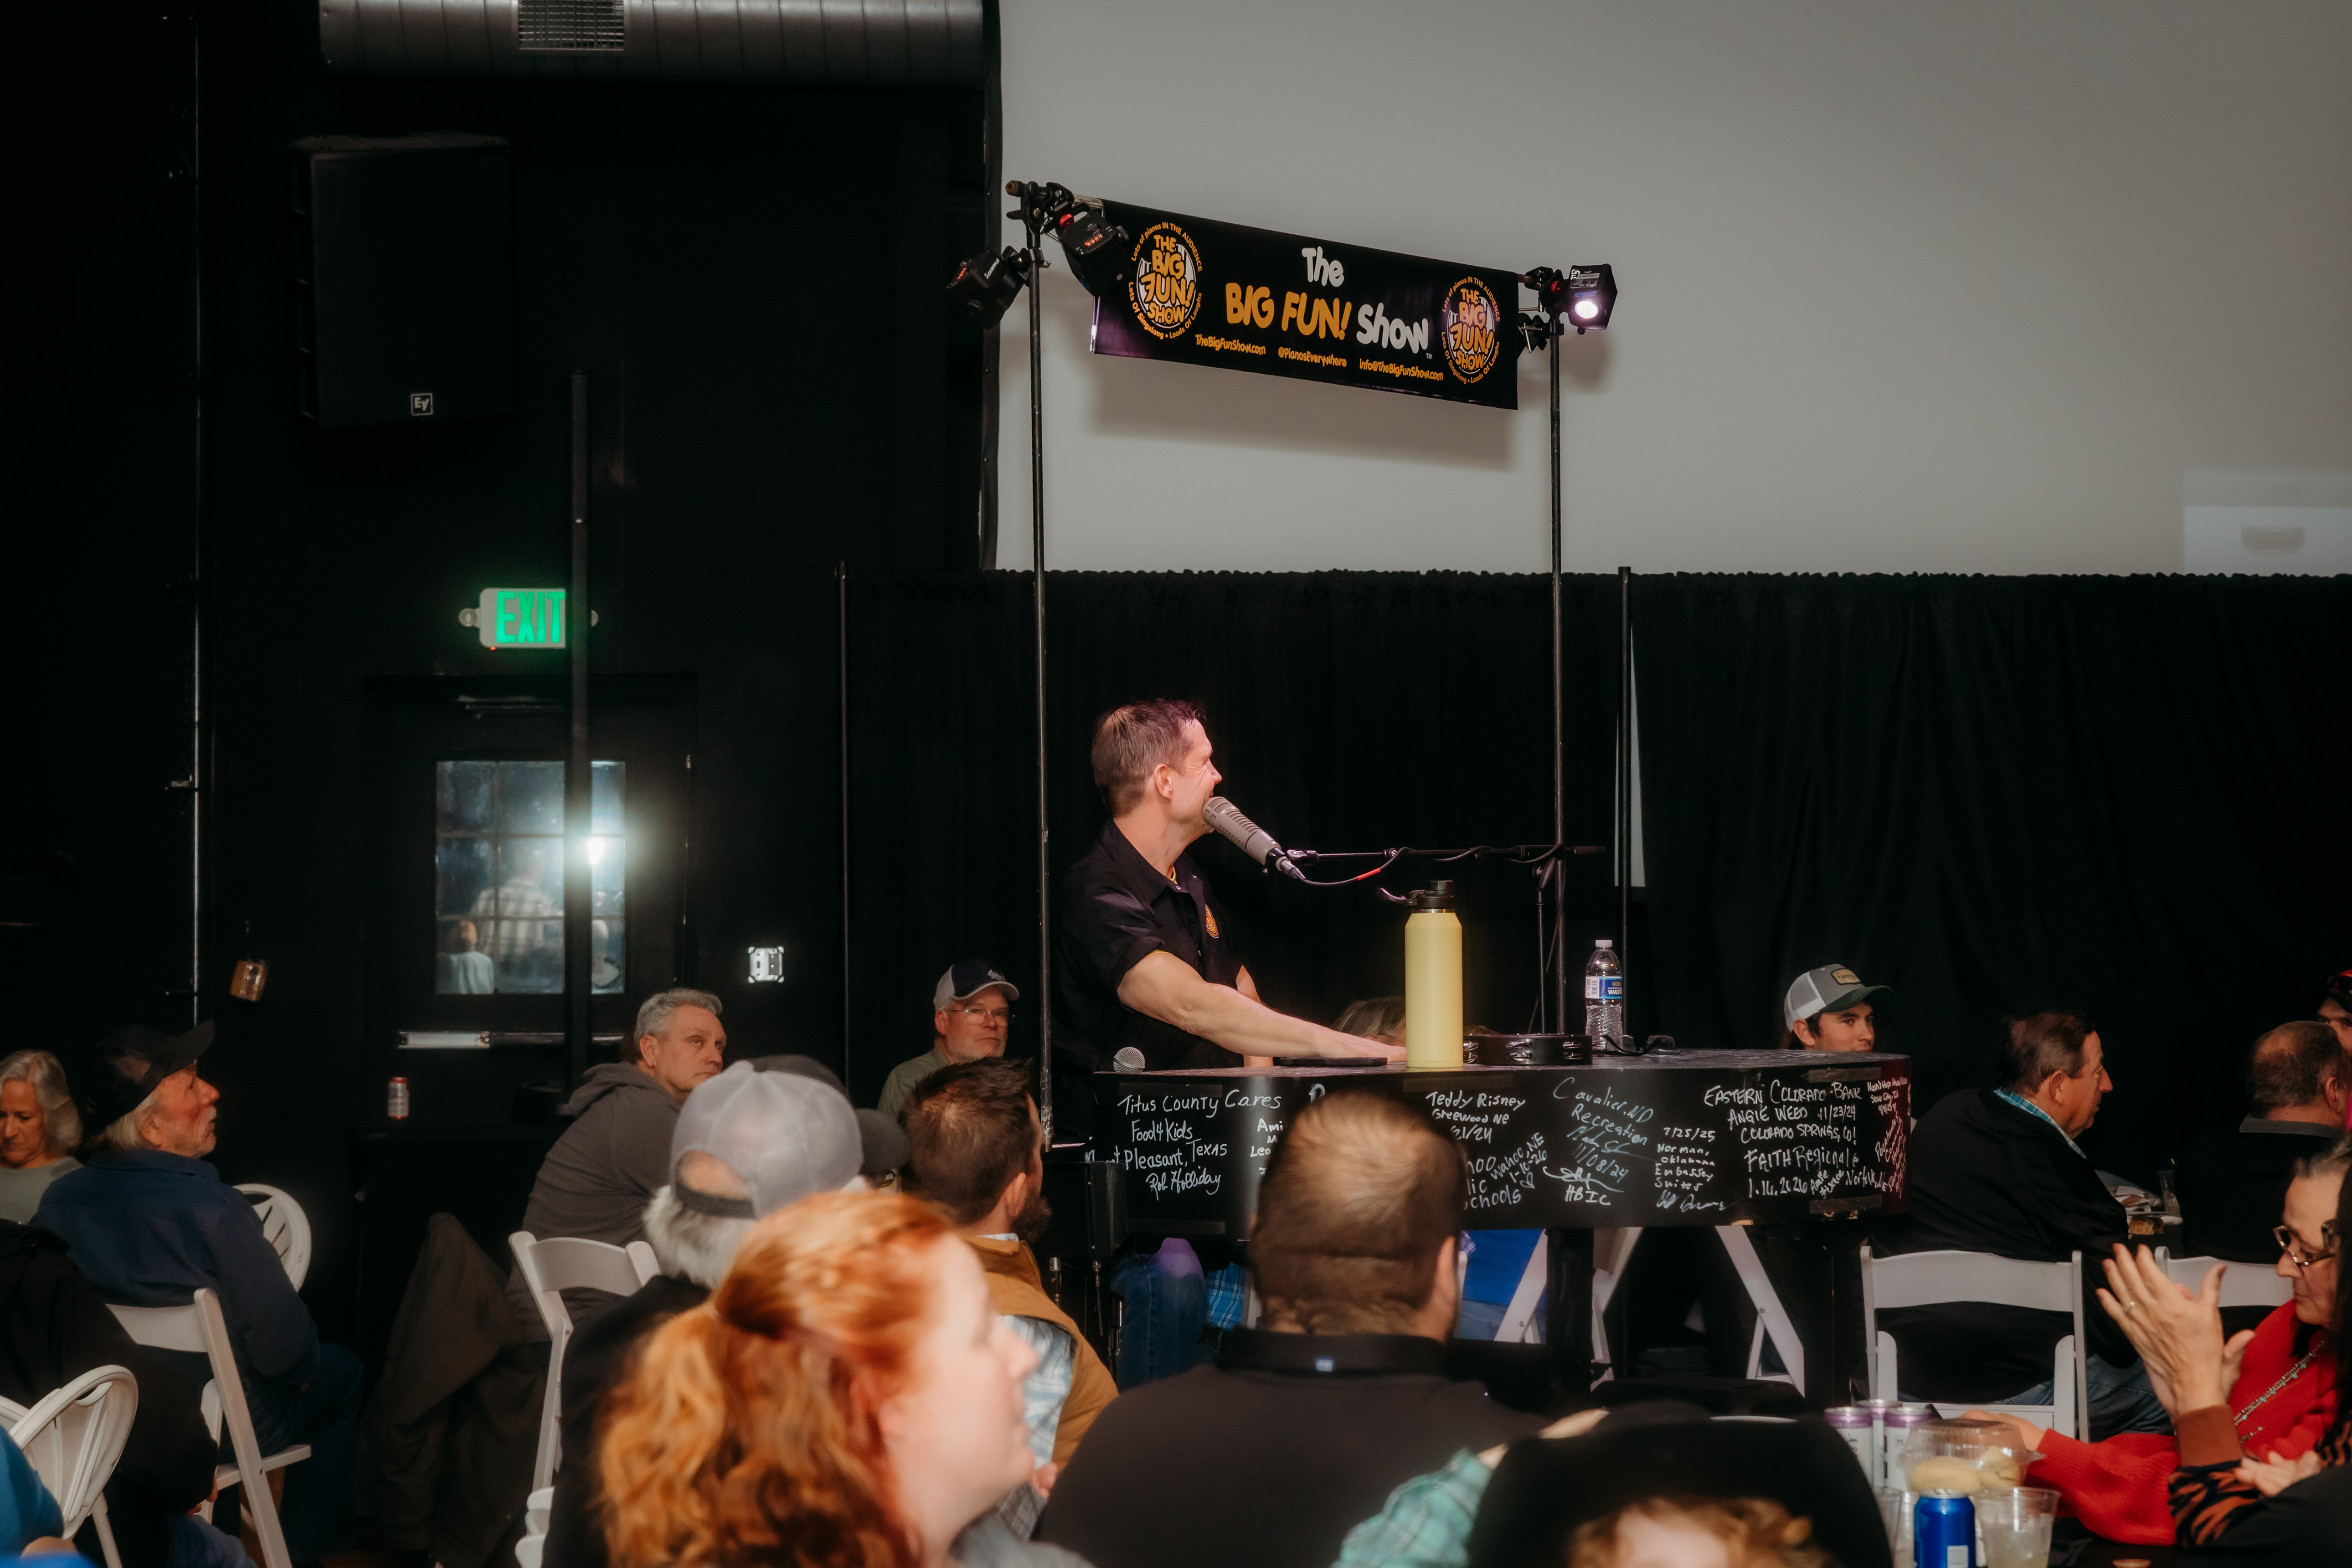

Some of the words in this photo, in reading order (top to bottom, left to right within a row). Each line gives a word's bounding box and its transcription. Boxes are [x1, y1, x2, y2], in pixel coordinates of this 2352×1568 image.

[1131, 244, 1141, 262] Lots
[1139, 234, 1145, 244] of
[1144, 224, 1161, 239] pianos
[1170, 223, 1182, 235] THE
[1182, 232, 1203, 272] AUDIENCE
[1153, 235, 1176, 252] THE
[1152, 250, 1184, 280] BIG
[1302, 246, 1344, 287] The
[1141, 272, 1195, 307] FUN!
[1449, 288, 1453, 297] of
[1453, 278, 1467, 292] pianos
[1474, 277, 1483, 288] THE
[1483, 286, 1501, 322] AUDIENCE
[1461, 288, 1479, 305] THE
[1132, 302, 1140, 313] Of
[1137, 313, 1164, 339] Singalong
[1169, 327, 1185, 339] Loads
[1185, 318, 1192, 329] Of
[1190, 293, 1202, 321] Laughs
[1147, 302, 1185, 324] SHOW
[1225, 283, 1274, 329] BIG
[1281, 291, 1352, 340] FUN!
[1459, 302, 1486, 329] BIG
[1450, 323, 1494, 355] FUN!
[1448, 360, 1467, 384] Singalong
[1471, 373, 1483, 383] Loads
[1488, 341, 1500, 366] Laughs
[1455, 350, 1484, 370] SHOW
[496, 591, 566, 643] EXIT
[1117, 1095, 1156, 1115] Titus
[1225, 1089, 1282, 1109] Cares
[1426, 1090, 1473, 1109] Teddy
[1663, 1127, 1716, 1142] 7/25/25
[1744, 1149, 1791, 1172] FAITH
